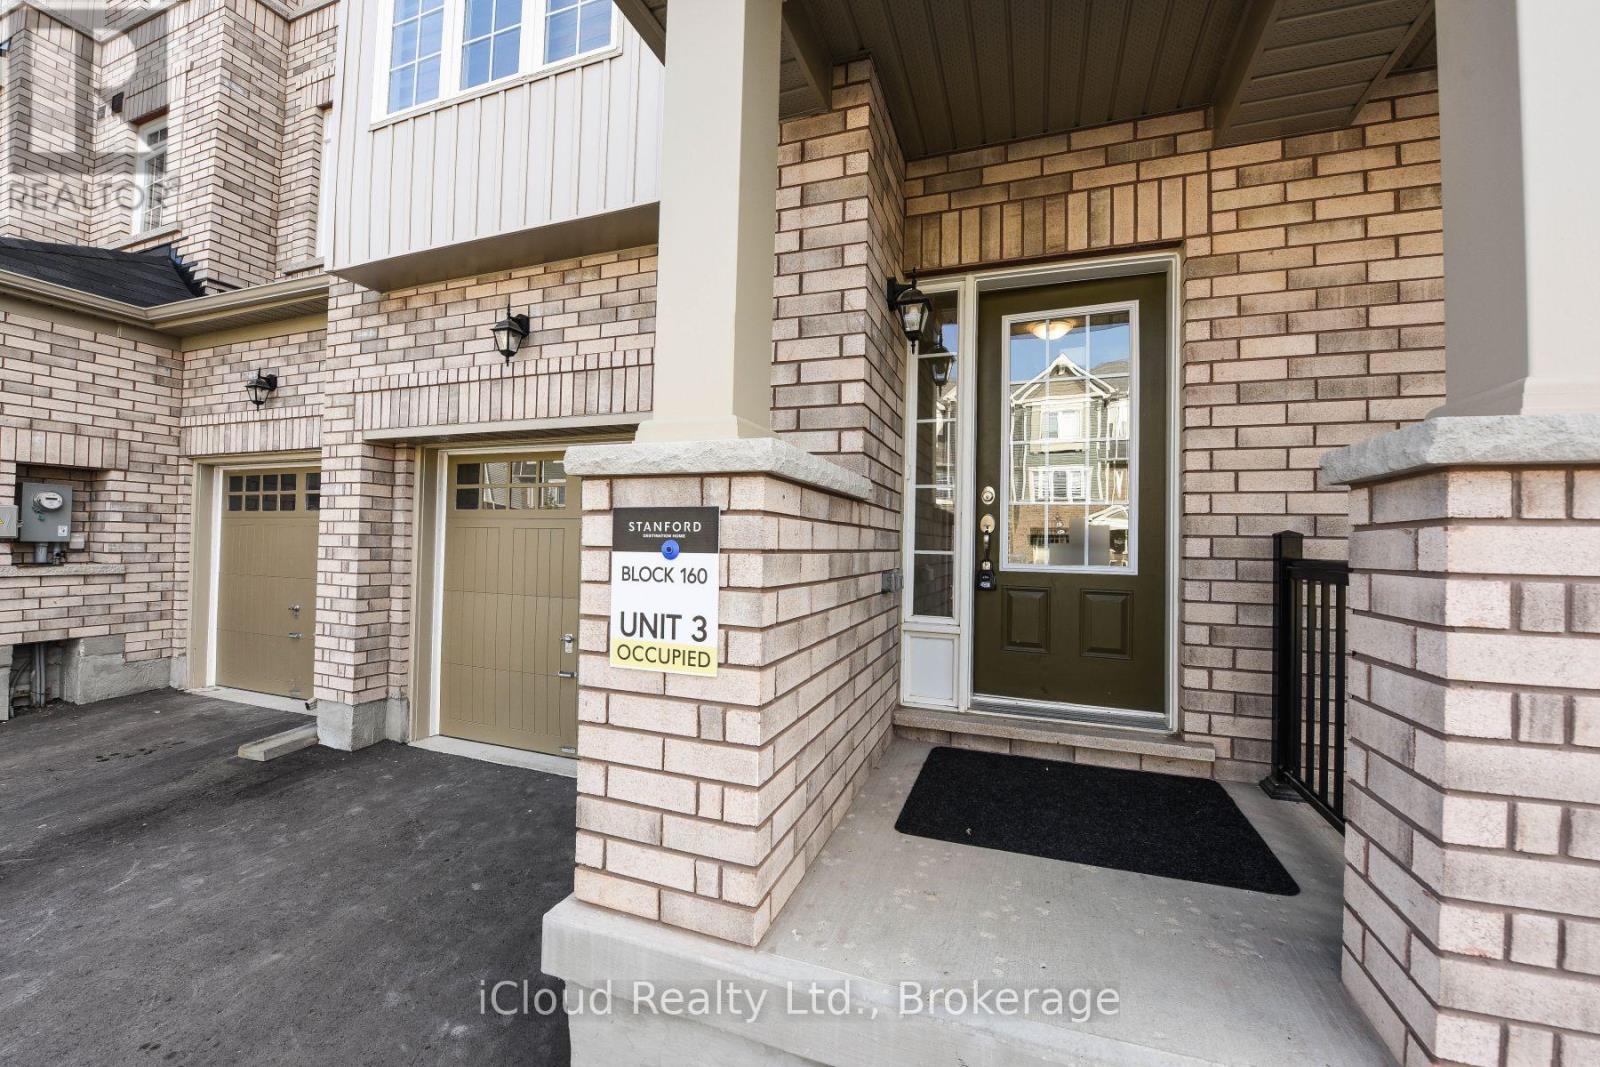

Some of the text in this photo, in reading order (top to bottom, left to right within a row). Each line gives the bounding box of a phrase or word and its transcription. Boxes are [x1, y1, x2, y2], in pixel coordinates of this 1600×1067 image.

[628, 521, 702, 532] STANFORD
[621, 565, 708, 584] BLOCK 160
[620, 611, 708, 642] UNIT 3
[617, 644, 711, 668] OCCUPIED
